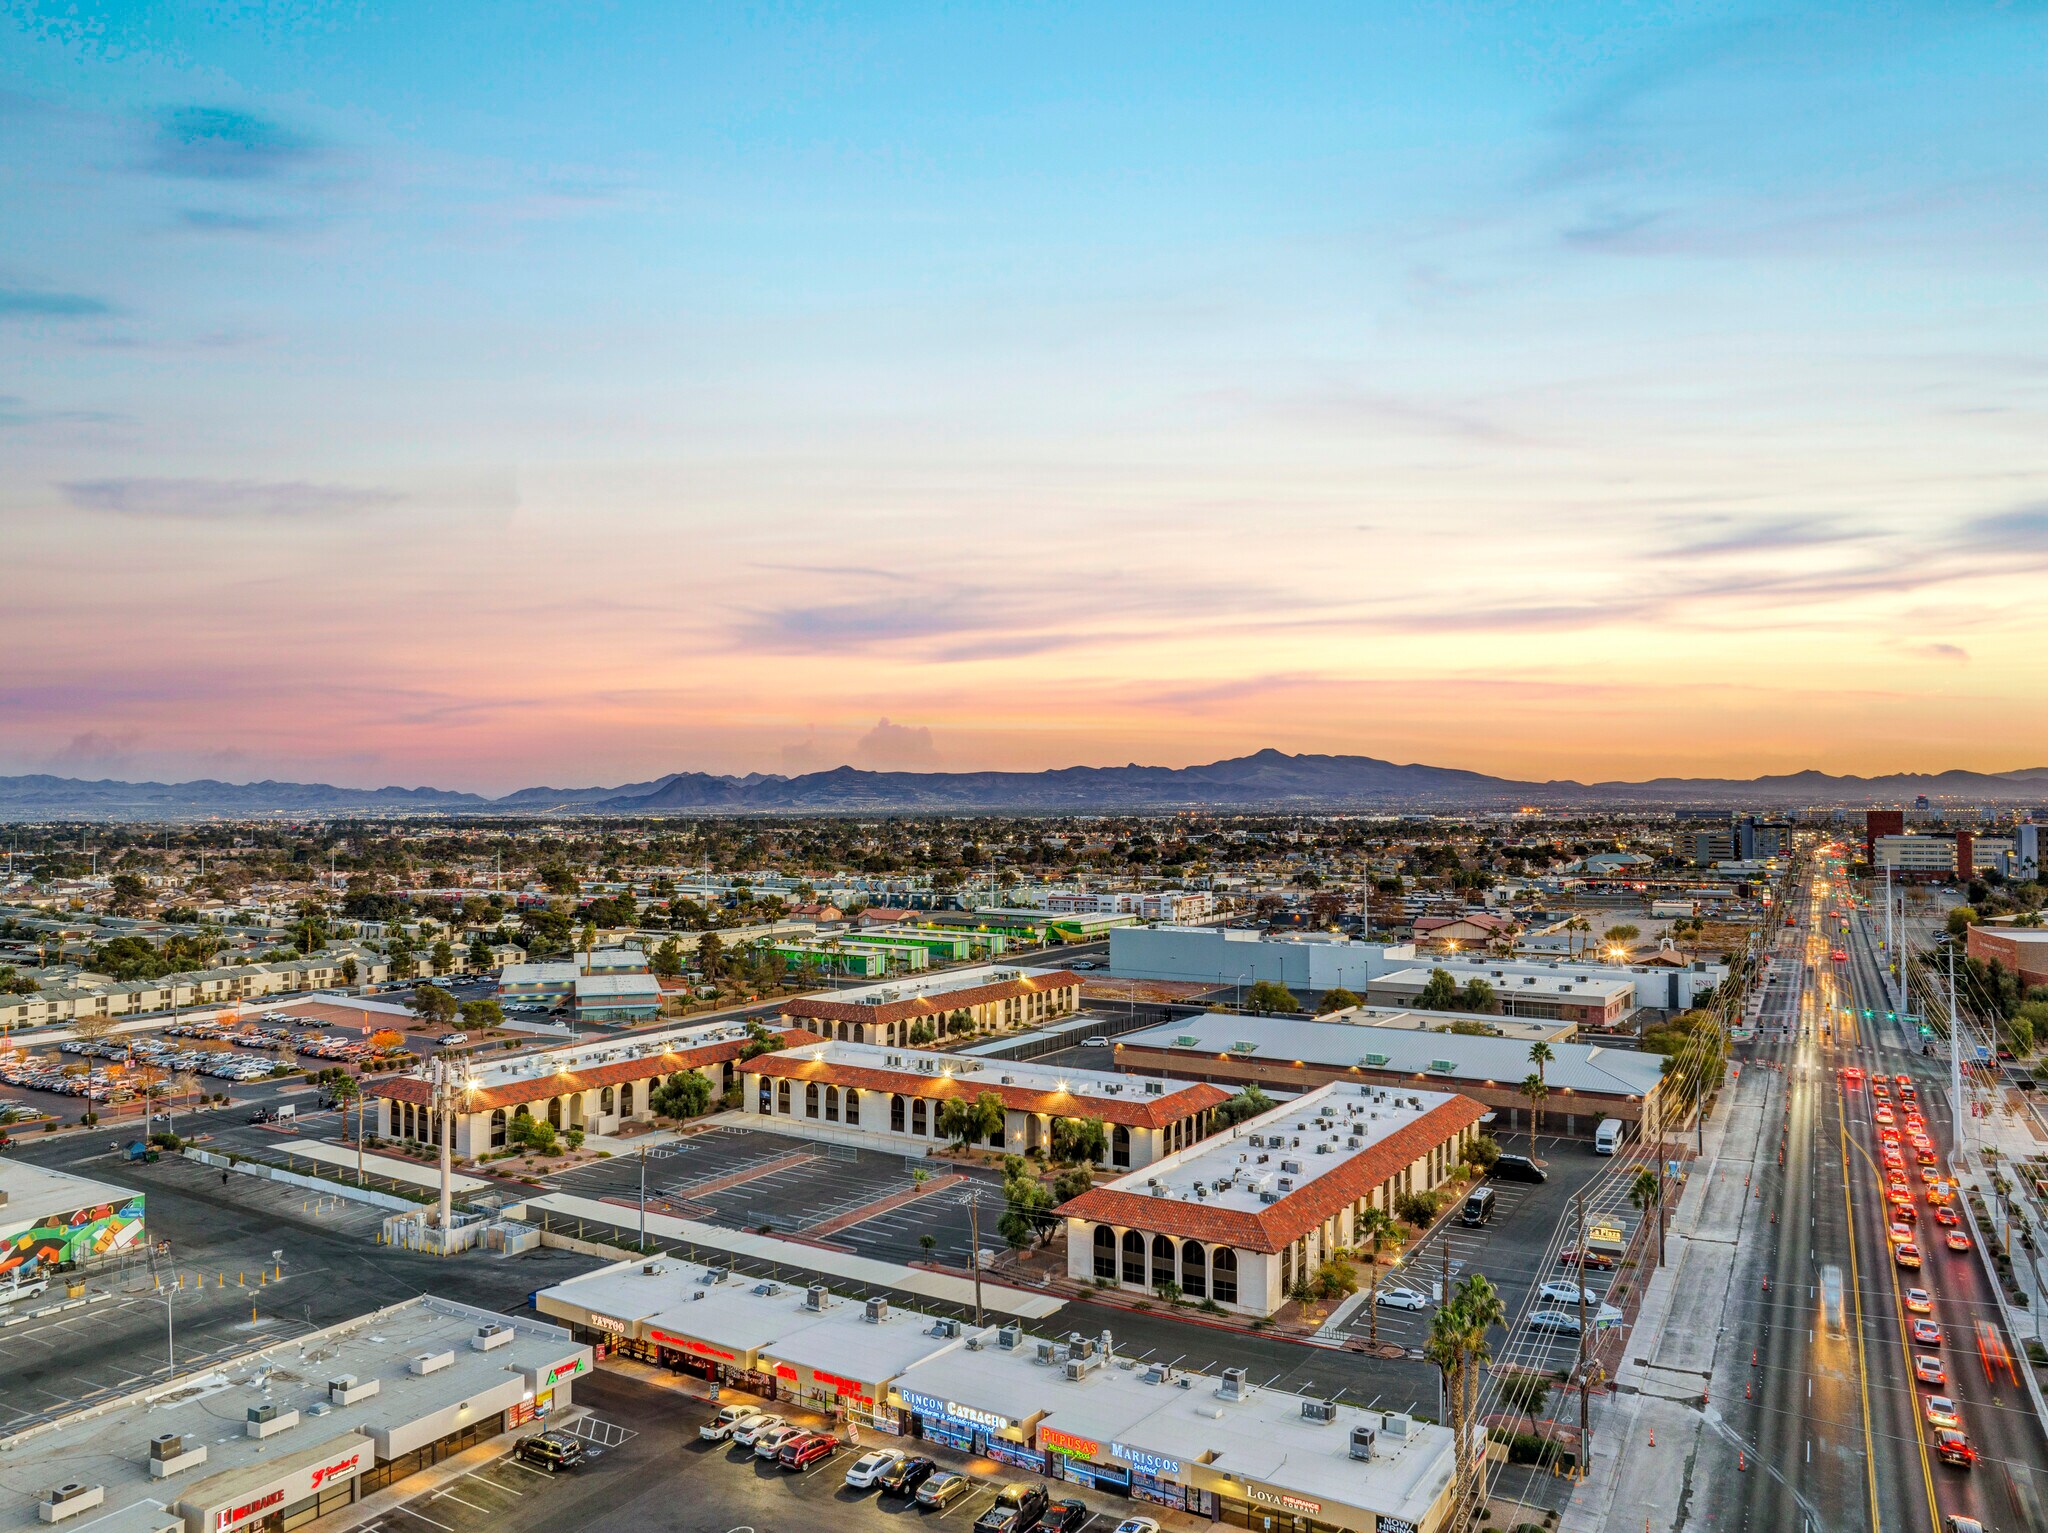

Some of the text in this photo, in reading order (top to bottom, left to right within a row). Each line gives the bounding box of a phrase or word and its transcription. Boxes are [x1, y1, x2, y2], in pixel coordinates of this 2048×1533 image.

[591, 1314, 625, 1333] TATTOO
[813, 1370, 862, 1393] SMOKE
[902, 1389, 944, 1412] RINCON
[947, 1401, 1008, 1430] CATRACHO
[1041, 1427, 1098, 1455] PUPUSAS
[1047, 1444, 1075, 1457] Mexican
[1074, 1449, 1091, 1460] Food
[1111, 1442, 1179, 1473] MARISCOS
[1132, 1462, 1158, 1475] Seafood
[1246, 1485, 1281, 1505] LOYA
[1282, 1495, 1321, 1510] INSURANCE
[1283, 1501, 1319, 1515] COMPANY
[1384, 1517, 1409, 1530] NOW
